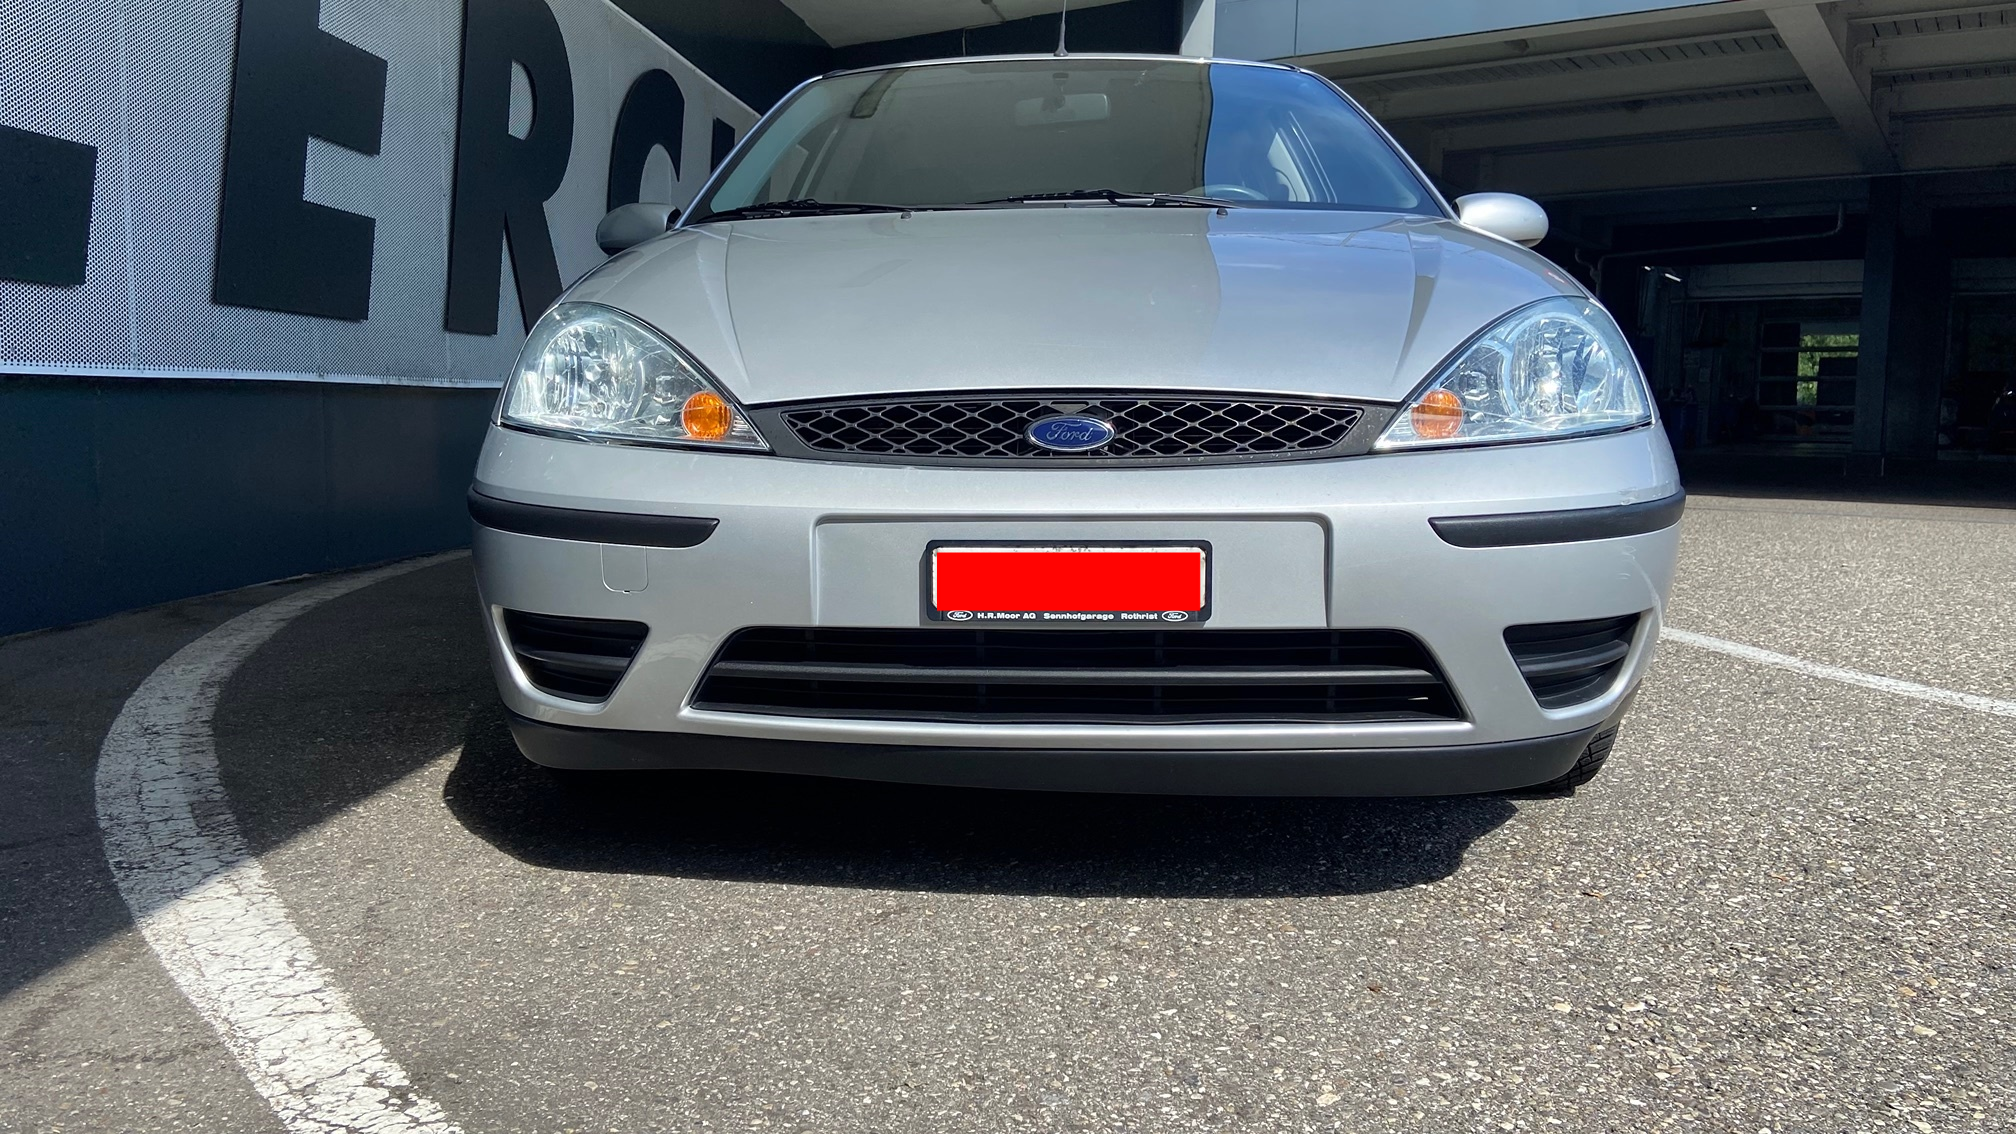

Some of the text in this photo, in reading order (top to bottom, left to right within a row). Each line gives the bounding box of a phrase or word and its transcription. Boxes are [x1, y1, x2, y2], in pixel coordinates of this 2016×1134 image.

[1046, 422, 1094, 441] Ford
[977, 612, 1158, 621] H.R.Moor AG Sennhofgarage Rothrist
